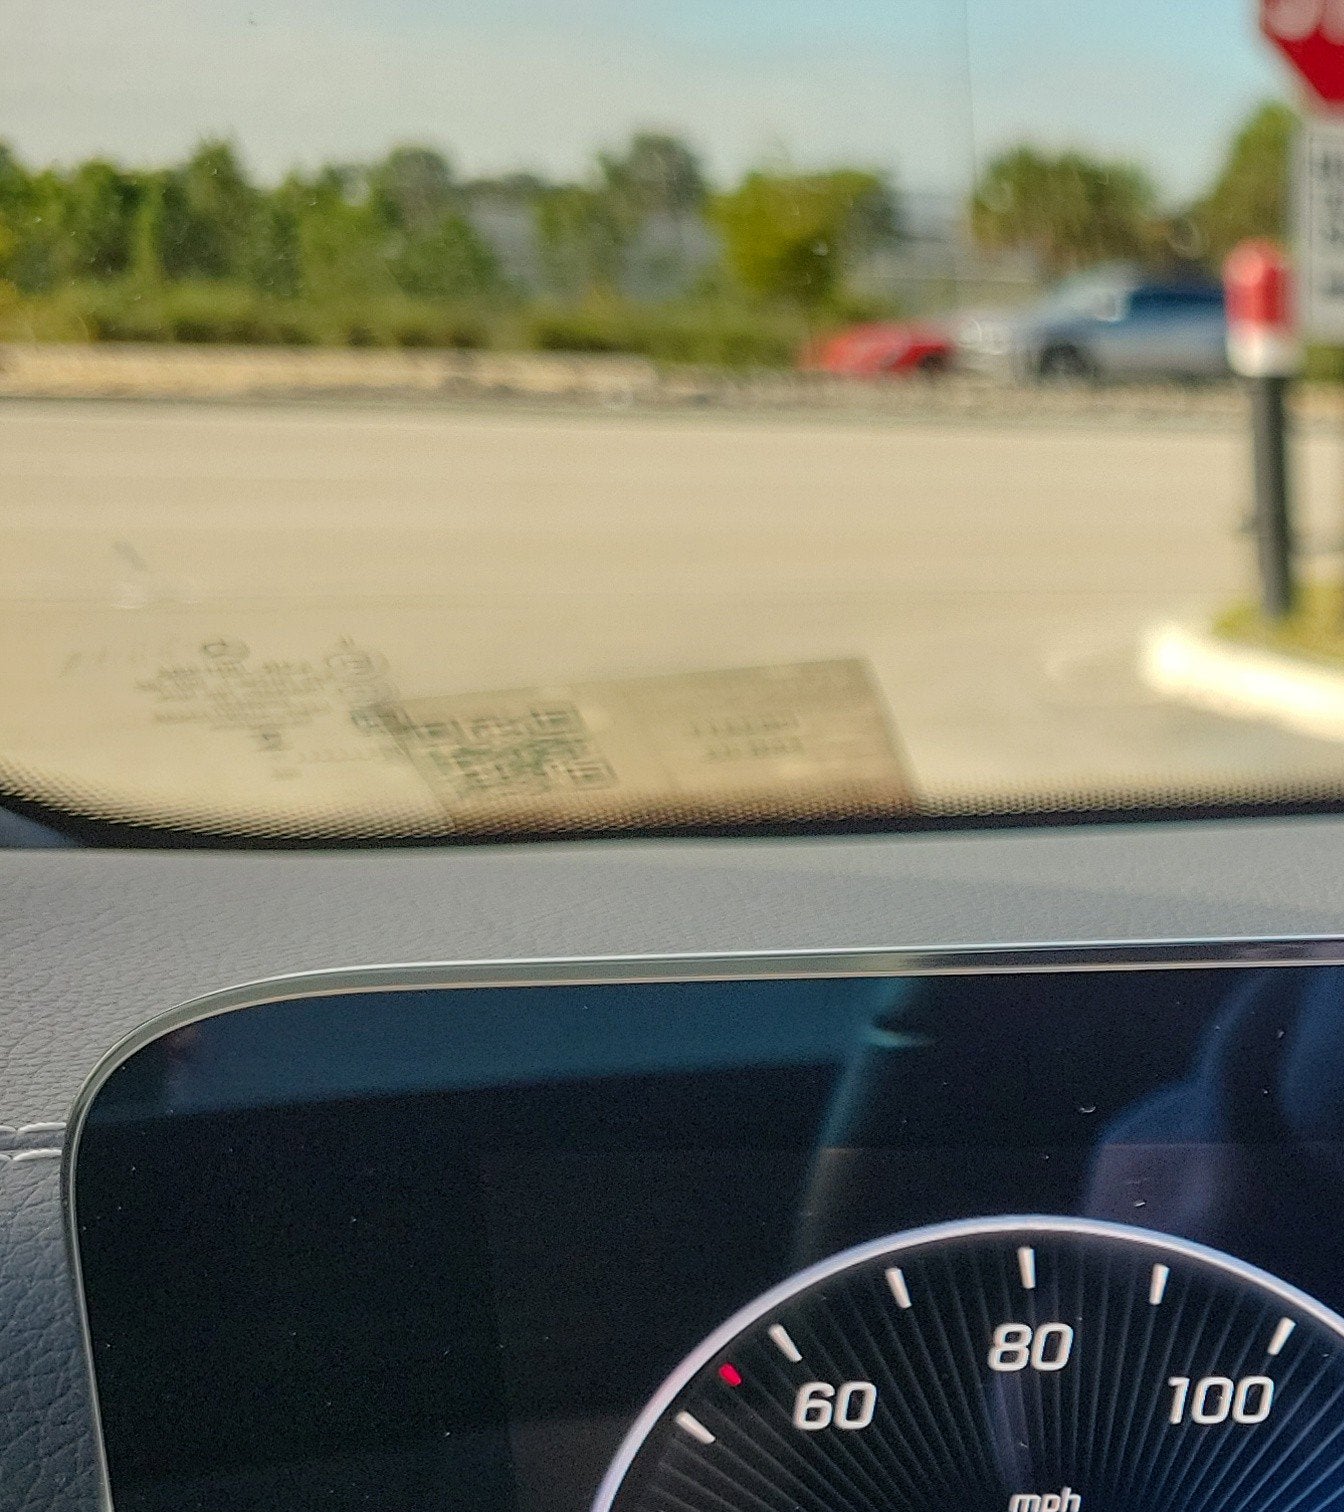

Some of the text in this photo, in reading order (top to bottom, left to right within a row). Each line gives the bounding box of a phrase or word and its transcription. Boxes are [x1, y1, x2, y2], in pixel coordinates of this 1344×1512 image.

[988, 1322, 1074, 1372] 80
[793, 1381, 877, 1431] 60
[1168, 1375, 1274, 1425] 100
